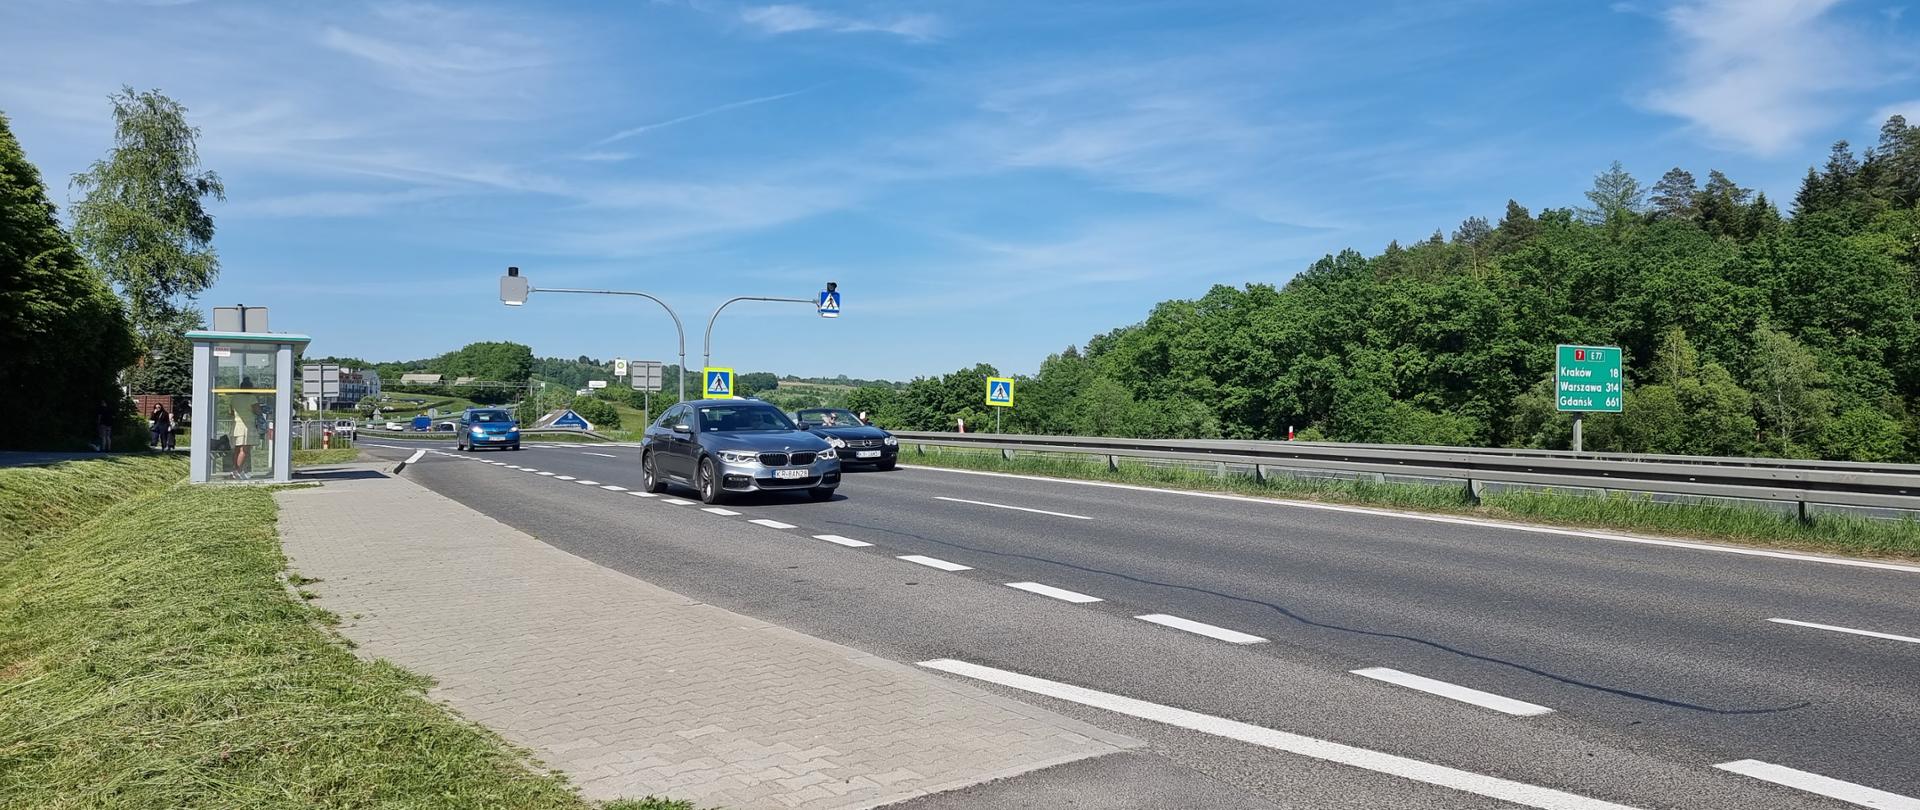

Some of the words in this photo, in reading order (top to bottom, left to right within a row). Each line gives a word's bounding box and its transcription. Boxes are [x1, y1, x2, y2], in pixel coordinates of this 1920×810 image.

[1596, 352, 1602, 360] 77
[1560, 366, 1592, 378] Kraków
[1610, 368, 1619, 378] 18
[1560, 381, 1602, 392] Warszawa
[1605, 382, 1619, 392] 314
[1560, 396, 1593, 406] Gdańsk
[1606, 397, 1620, 407] 661
